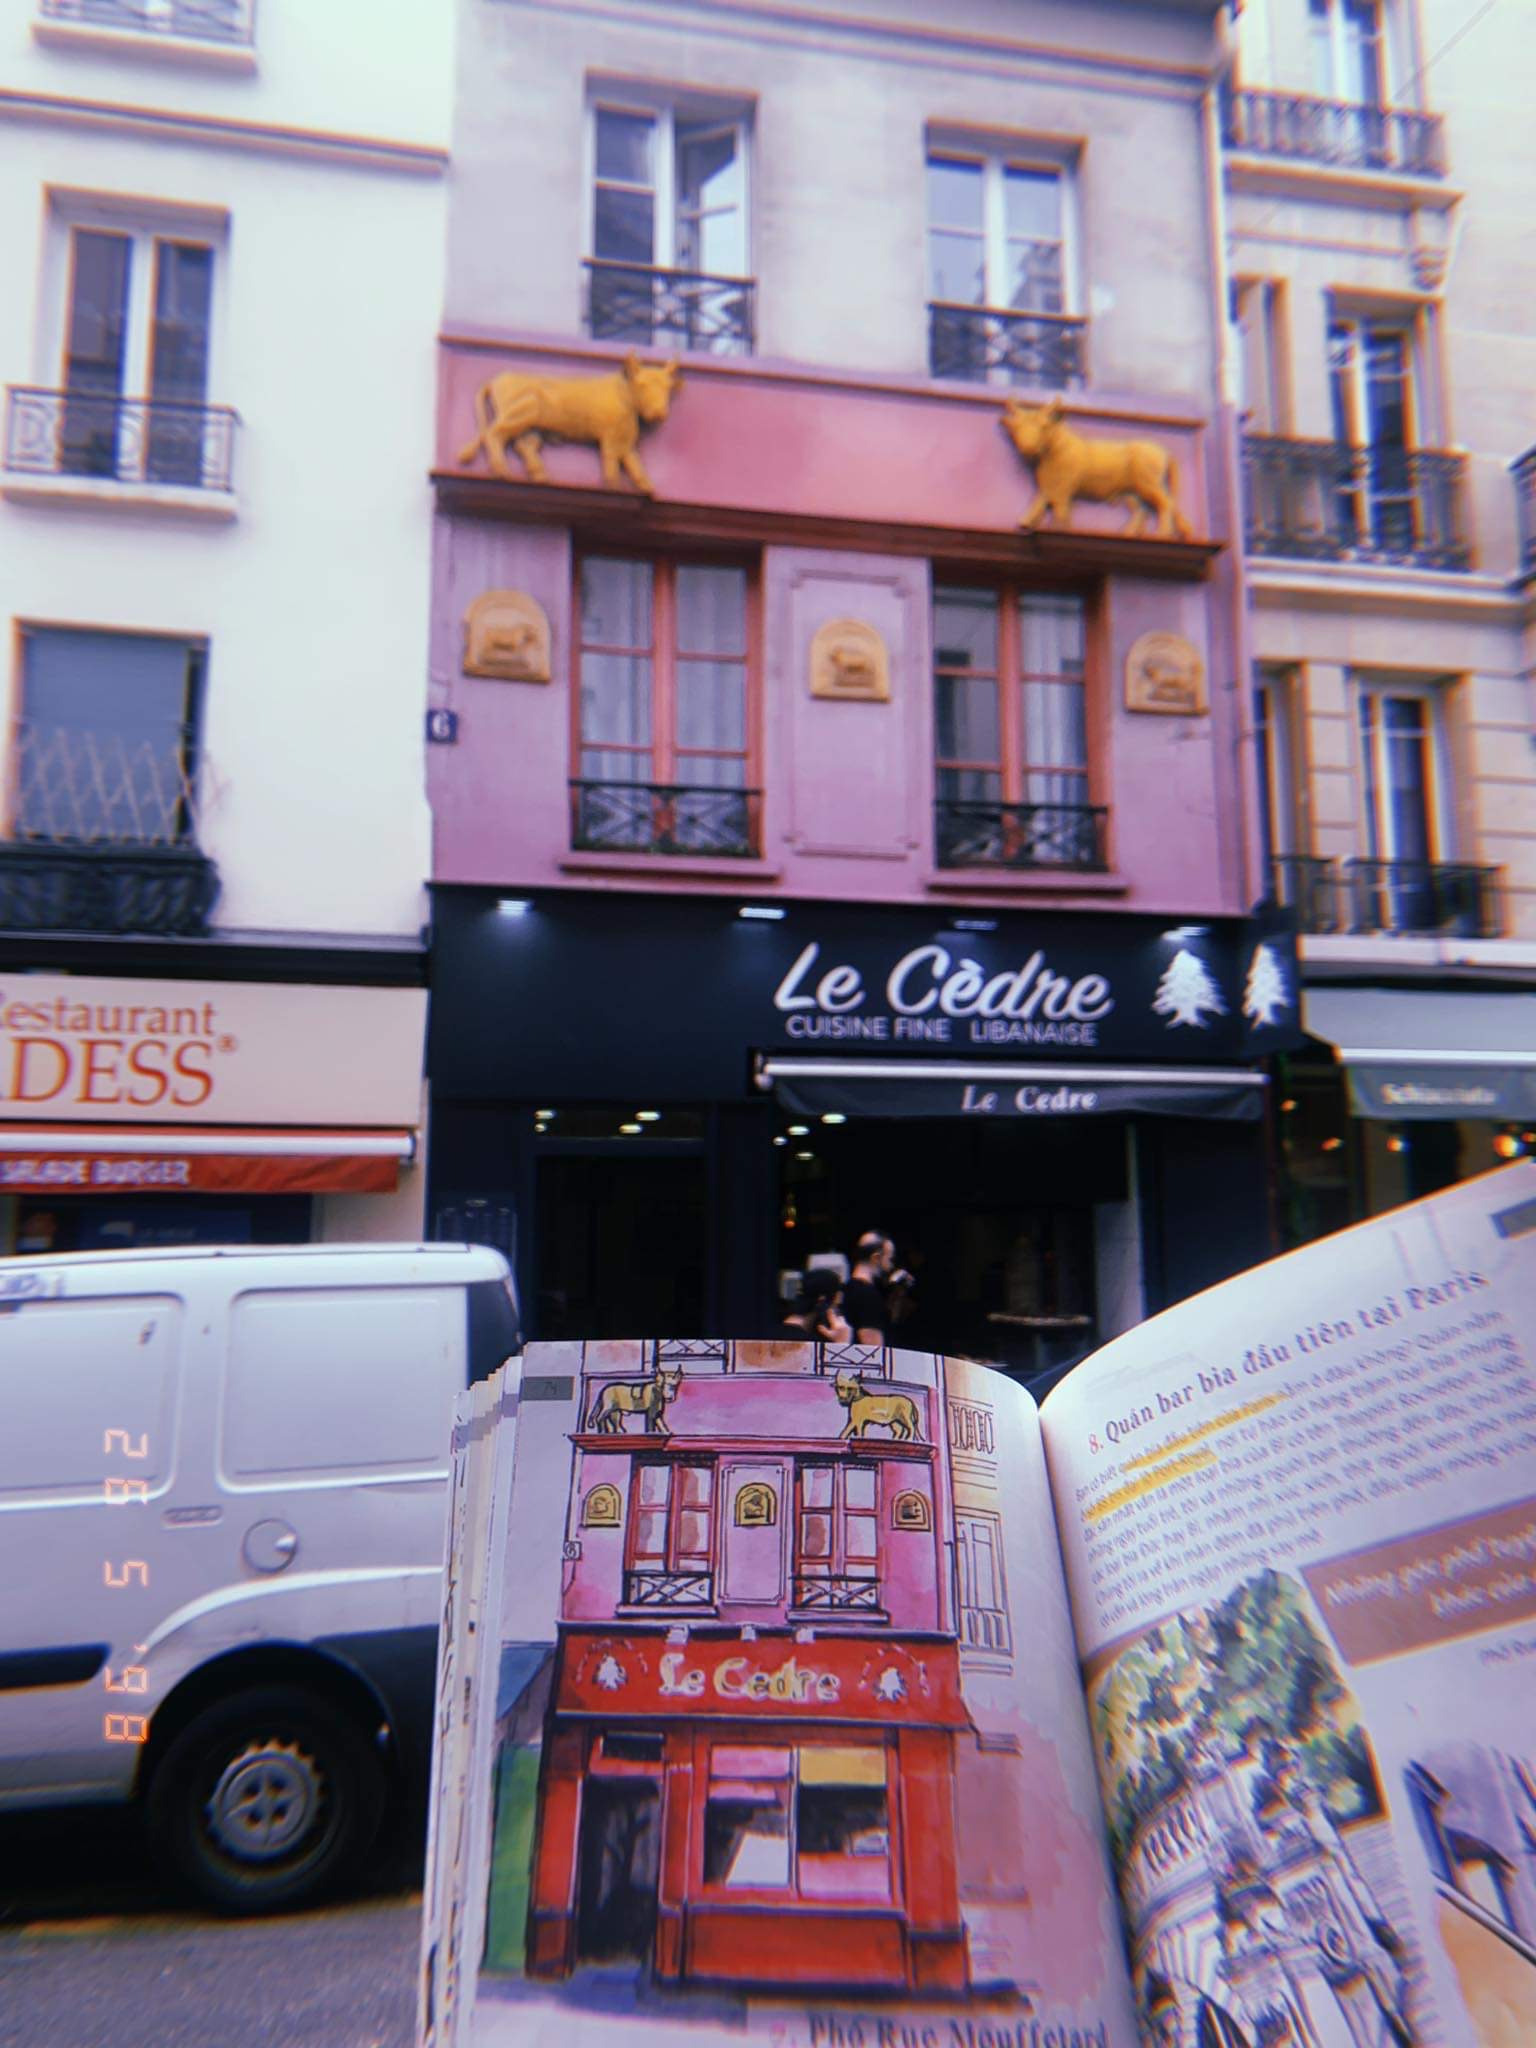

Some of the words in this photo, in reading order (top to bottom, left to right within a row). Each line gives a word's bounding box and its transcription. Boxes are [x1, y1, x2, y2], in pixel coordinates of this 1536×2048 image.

[774, 941, 866, 1013] Le
[0, 990, 215, 1036] estaurant
[785, 1014, 888, 1040] CUISINE
[893, 1016, 951, 1041] FINE
[970, 1019, 1097, 1046] LIBANAISE
[961, 1084, 999, 1113] Le
[1015, 1085, 1097, 1113] Cedre
[91, 1160, 190, 1185] BURGER
[1088, 1433, 1104, 1455] 8.
[1155, 1384, 1195, 1416] bar
[1197, 1366, 1238, 1394] bia
[1294, 1321, 1356, 1354] tiên
[1405, 1268, 1491, 1311] Paris
[658, 1653, 705, 1697] Le
[713, 1656, 841, 1703] Cedre
